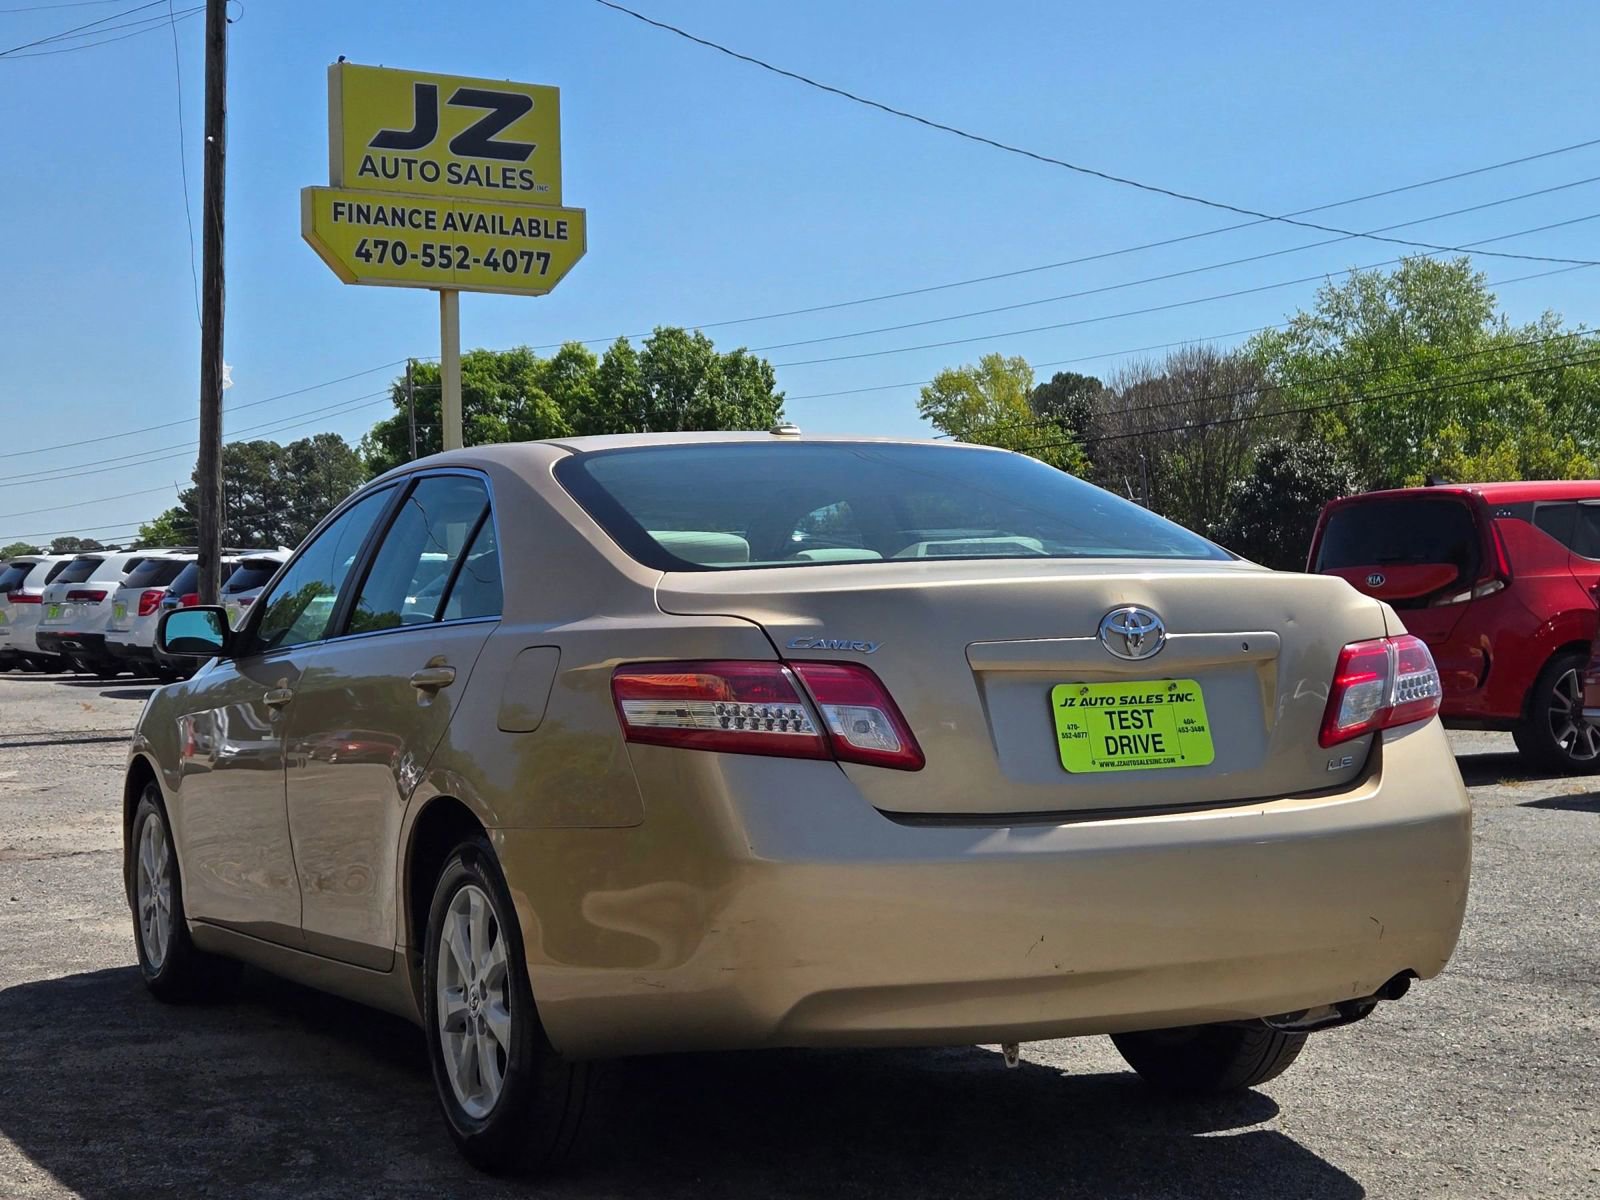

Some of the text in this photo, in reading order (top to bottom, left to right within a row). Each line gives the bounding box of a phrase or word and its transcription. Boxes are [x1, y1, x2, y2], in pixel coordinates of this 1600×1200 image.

[368, 82, 536, 161] JZ
[358, 155, 440, 182] AUTO
[447, 163, 534, 191] SALES
[333, 202, 568, 240] FINANCE AVAILABLE
[355, 238, 551, 275] 470-552-4077
[1368, 575, 1381, 585] KIA
[786, 636, 884, 654] CAMRY
[1060, 693, 1195, 707] JZ AUTO SALES INC.
[1104, 709, 1154, 731] TEST
[1105, 733, 1165, 756] DRIVE
[1099, 757, 1176, 768] WWW.JZAUTOSALESINC.COM
[1327, 755, 1353, 771] LE
